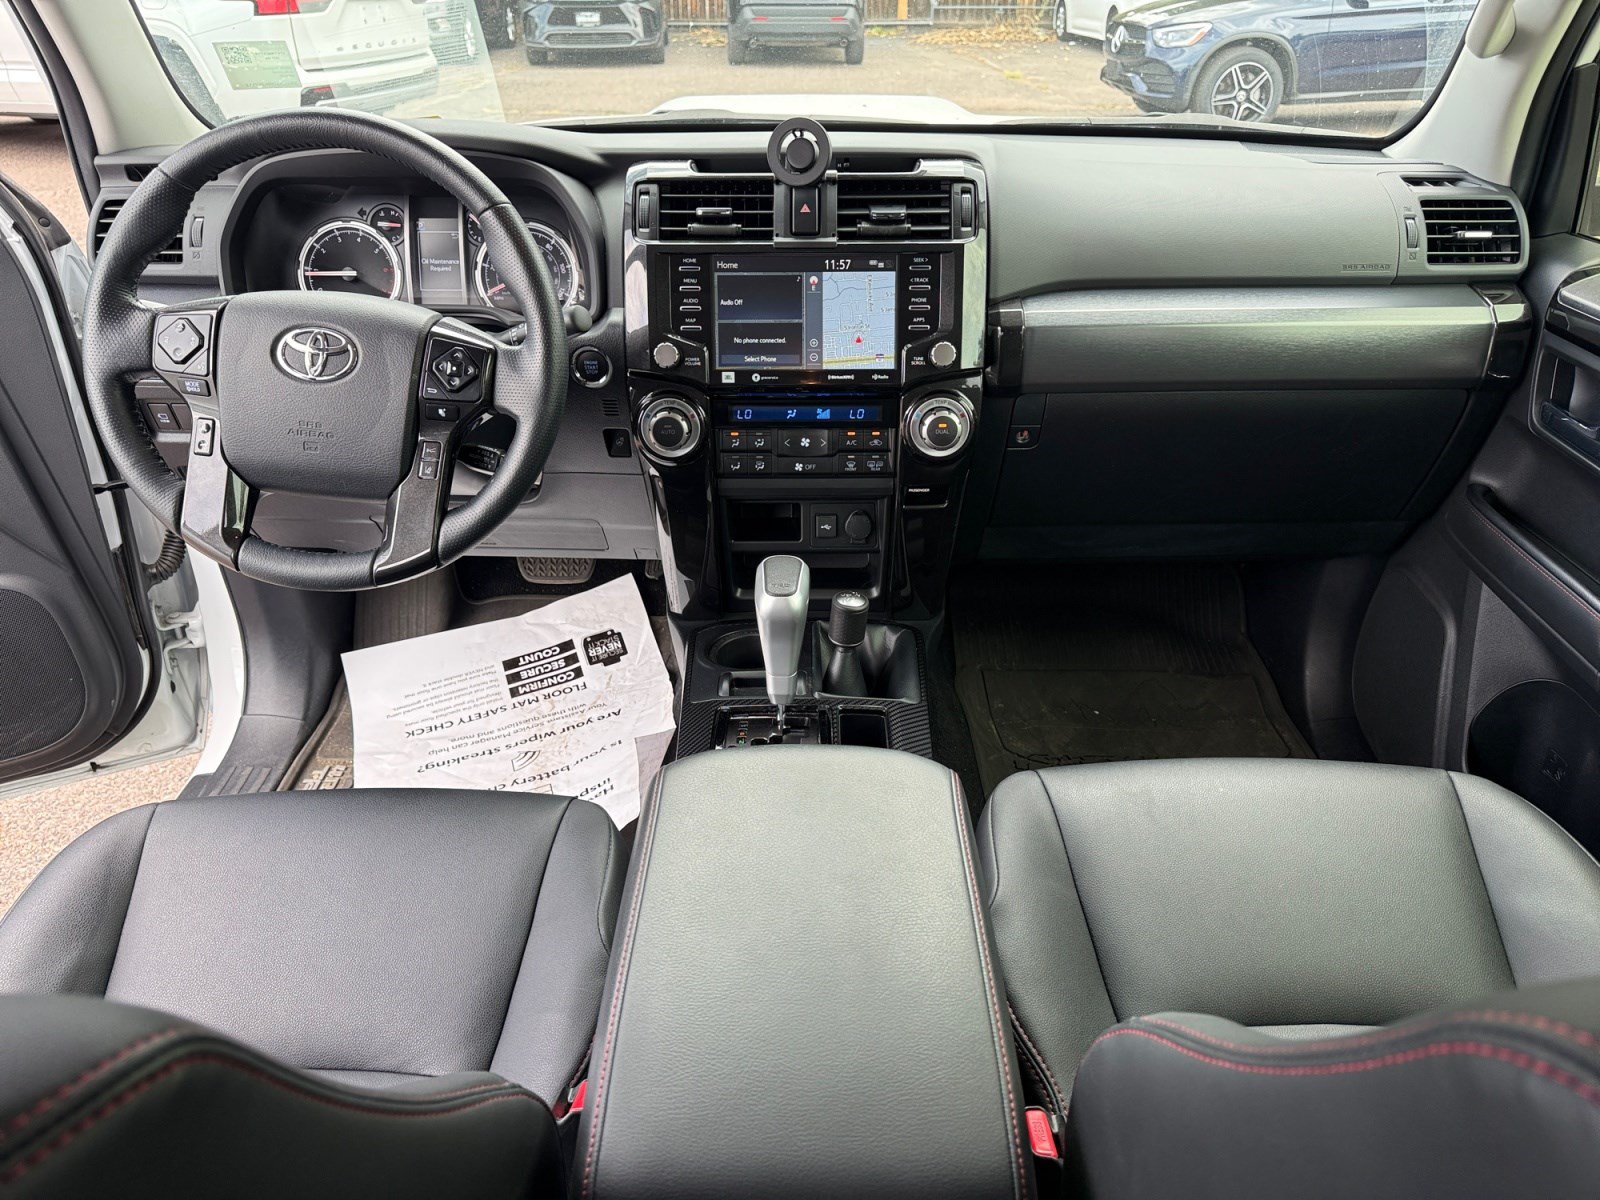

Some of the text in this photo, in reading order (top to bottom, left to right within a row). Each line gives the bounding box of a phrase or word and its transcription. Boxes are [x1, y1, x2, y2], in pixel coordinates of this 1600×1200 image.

[421, 257, 460, 266] Oil Maintenance
[716, 261, 739, 270] Home
[824, 259, 851, 270] 11:57
[743, 337, 759, 345] phone
[287, 428, 335, 439] AIRBAG
[804, 463, 817, 471] OFF
[594, 634, 619, 647] STACK
[588, 640, 621, 656] NEVER
[518, 646, 559, 665] COUNT
[520, 659, 565, 678] SECURE
[518, 671, 574, 693] CONFIRM
[406, 682, 586, 737] FLOOR MAT SAFETY CHECK
[567, 703, 586, 711] with
[541, 709, 565, 718] these
[497, 716, 539, 731] questions
[513, 721, 544, 733] Service
[470, 731, 510, 745] Manager
[476, 729, 494, 737] and
[417, 708, 620, 772] Are your wipers streaking?
[428, 747, 449, 755] help
[574, 746, 606, 765] your
[511, 765, 569, 785] battery
